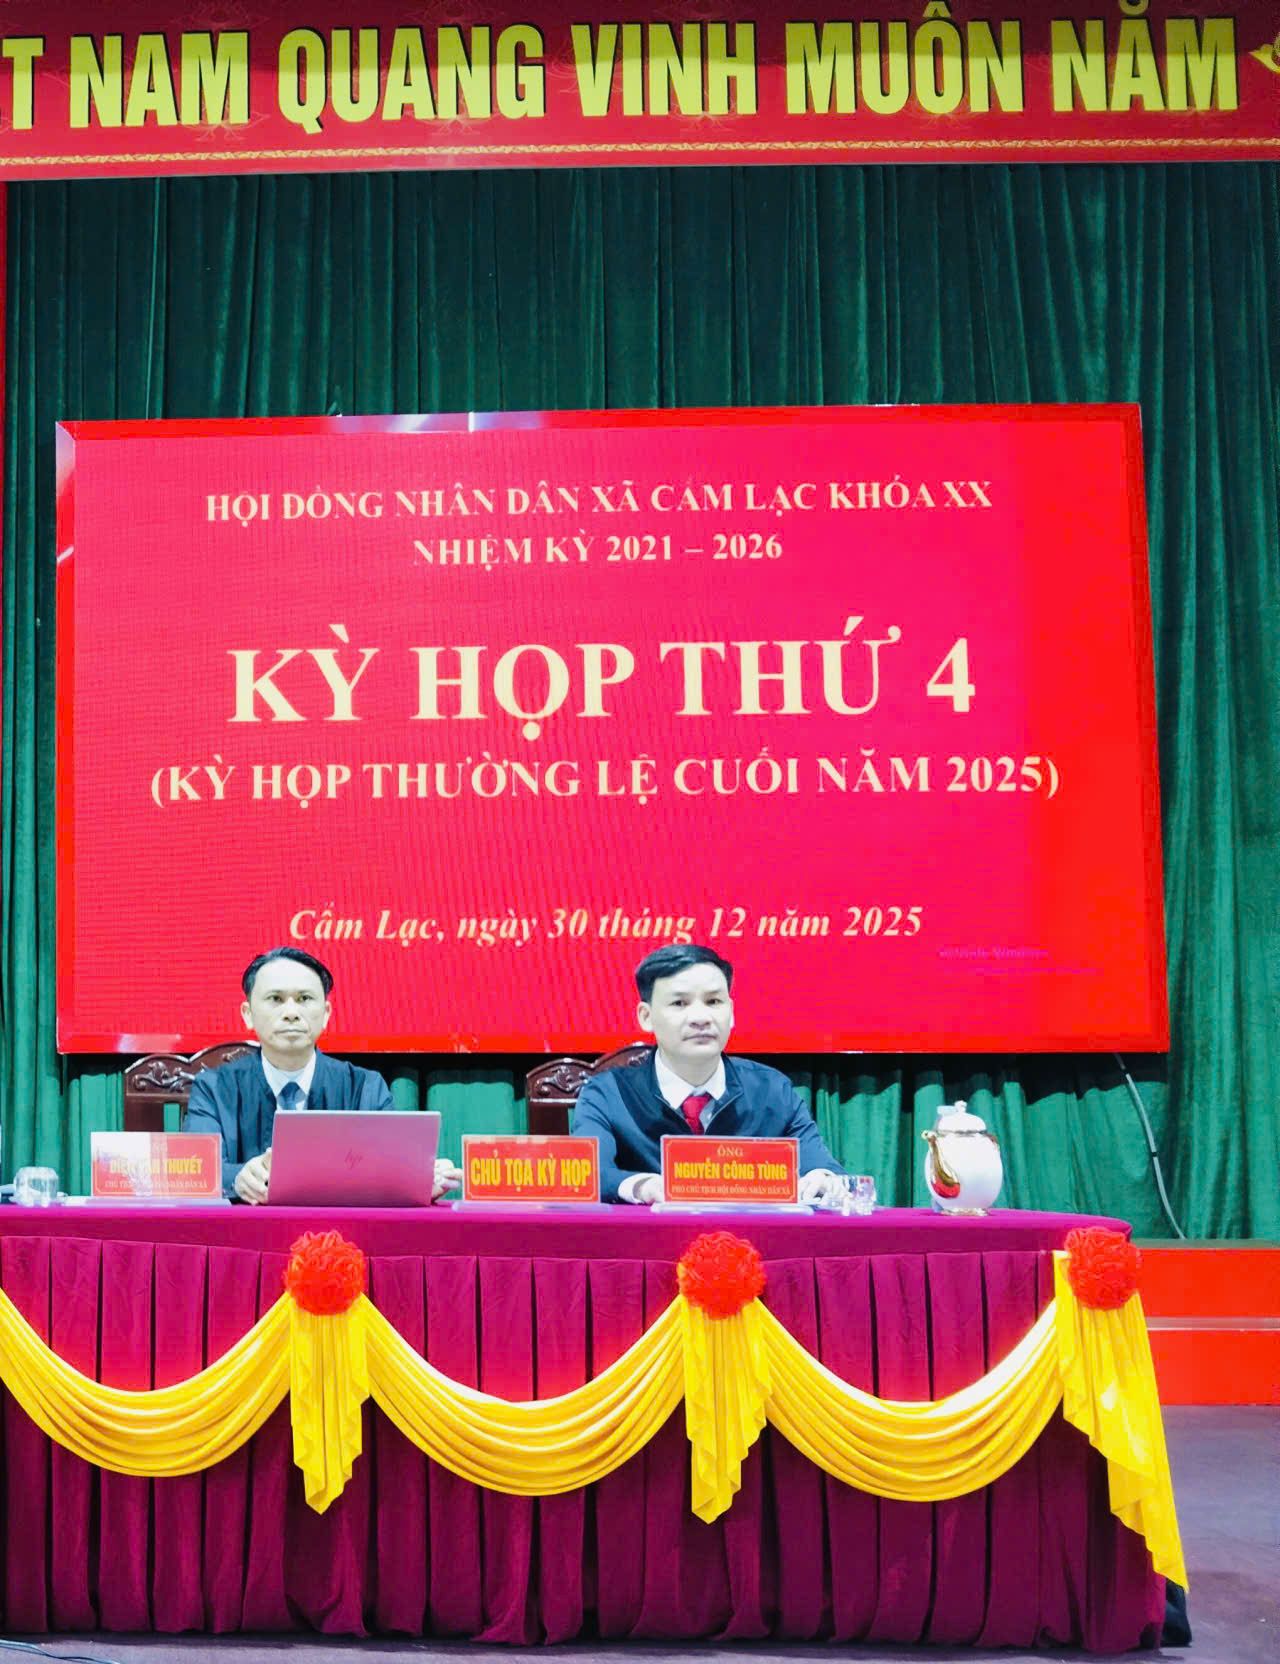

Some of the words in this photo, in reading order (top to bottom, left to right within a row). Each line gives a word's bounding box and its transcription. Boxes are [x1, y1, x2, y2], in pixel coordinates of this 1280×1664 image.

[70, 31, 250, 128] NAM
[278, 23, 545, 134] QUANG
[572, 22, 756, 117] VINH
[785, 0, 1024, 115] MUÔN
[1051, 0, 1238, 113] NĂM
[206, 490, 270, 527] HỘI
[395, 482, 495, 516] NHÂN
[507, 480, 580, 515] DÂN
[591, 481, 639, 512] XÃ
[745, 484, 817, 516] LẠC
[829, 475, 936, 509] KHÓA
[943, 481, 992, 508] XX
[413, 533, 532, 571] NHIỆM
[545, 529, 595, 563] KỲ
[606, 535, 672, 561] 2021
[713, 533, 783, 560] 2026
[226, 623, 380, 722] KỲ
[410, 642, 635, 741] HỌP
[660, 616, 902, 715] THỨ
[926, 638, 976, 713] 4
[151, 754, 235, 808] (KỲ
[252, 763, 351, 809] HỌP
[363, 751, 581, 799] THƯỜNG
[597, 753, 658, 805] LỆ
[674, 747, 799, 795] CUỐI
[816, 747, 930, 793] NĂM
[946, 756, 1060, 799] 2025)
[376, 909, 445, 946] Lạc,
[457, 908, 537, 947] ngày
[548, 908, 587, 938] 30
[599, 906, 696, 945] tháng
[709, 907, 745, 938] 12
[757, 907, 830, 937] năm
[843, 905, 923, 937] 2025
[471, 1149, 502, 1186] CHỦ
[505, 1158, 534, 1192] TỌA
[537, 1153, 557, 1187] KỲ
[560, 1158, 593, 1193] HỌP
[674, 1158, 721, 1180] NGUYỄN
[723, 1160, 755, 1180] CÔNG
[757, 1160, 788, 1181] TÙNG
[717, 1145, 744, 1157] ÔNG
